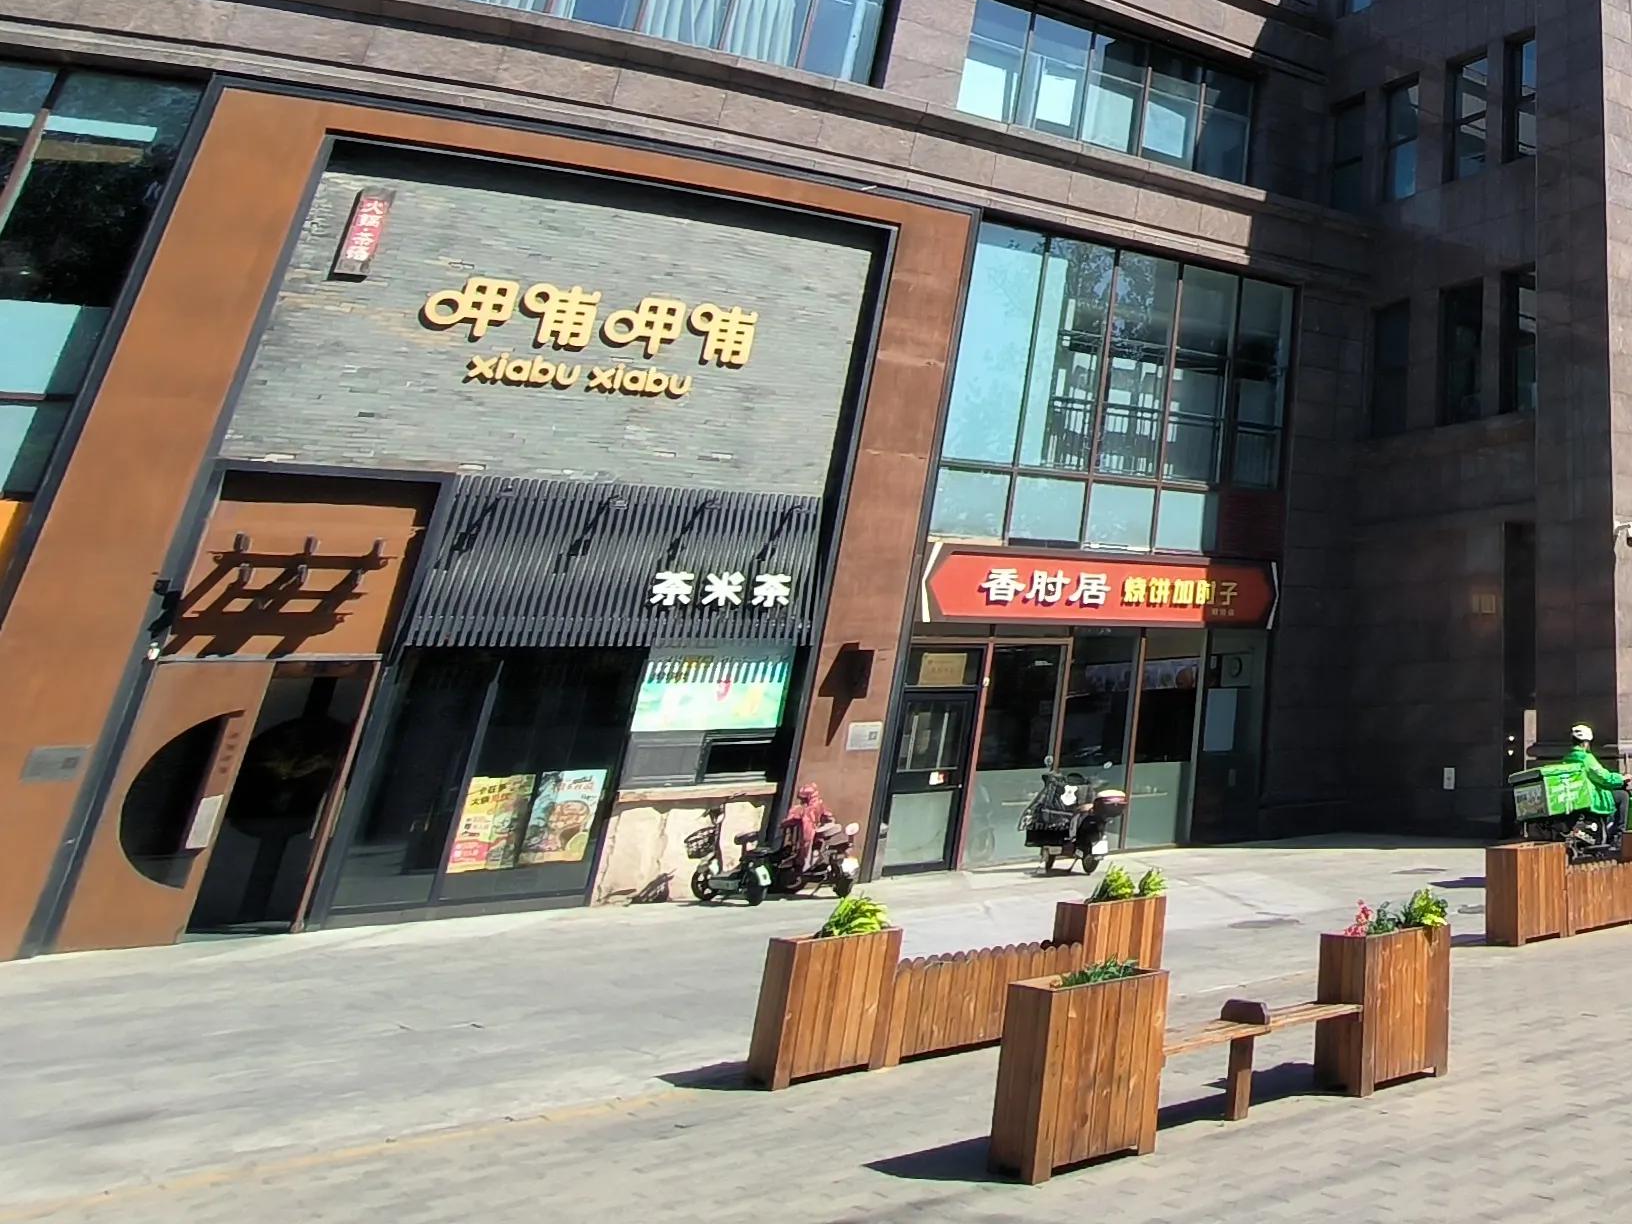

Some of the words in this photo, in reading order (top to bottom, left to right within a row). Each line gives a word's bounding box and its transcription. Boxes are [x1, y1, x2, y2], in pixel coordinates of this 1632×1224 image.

[424, 276, 760, 366] 呷哺呷哺
[467, 352, 582, 386] xiabu
[588, 363, 692, 396] xiabu
[649, 571, 792, 607] 茶米茶
[980, 568, 1112, 606] 香肘居
